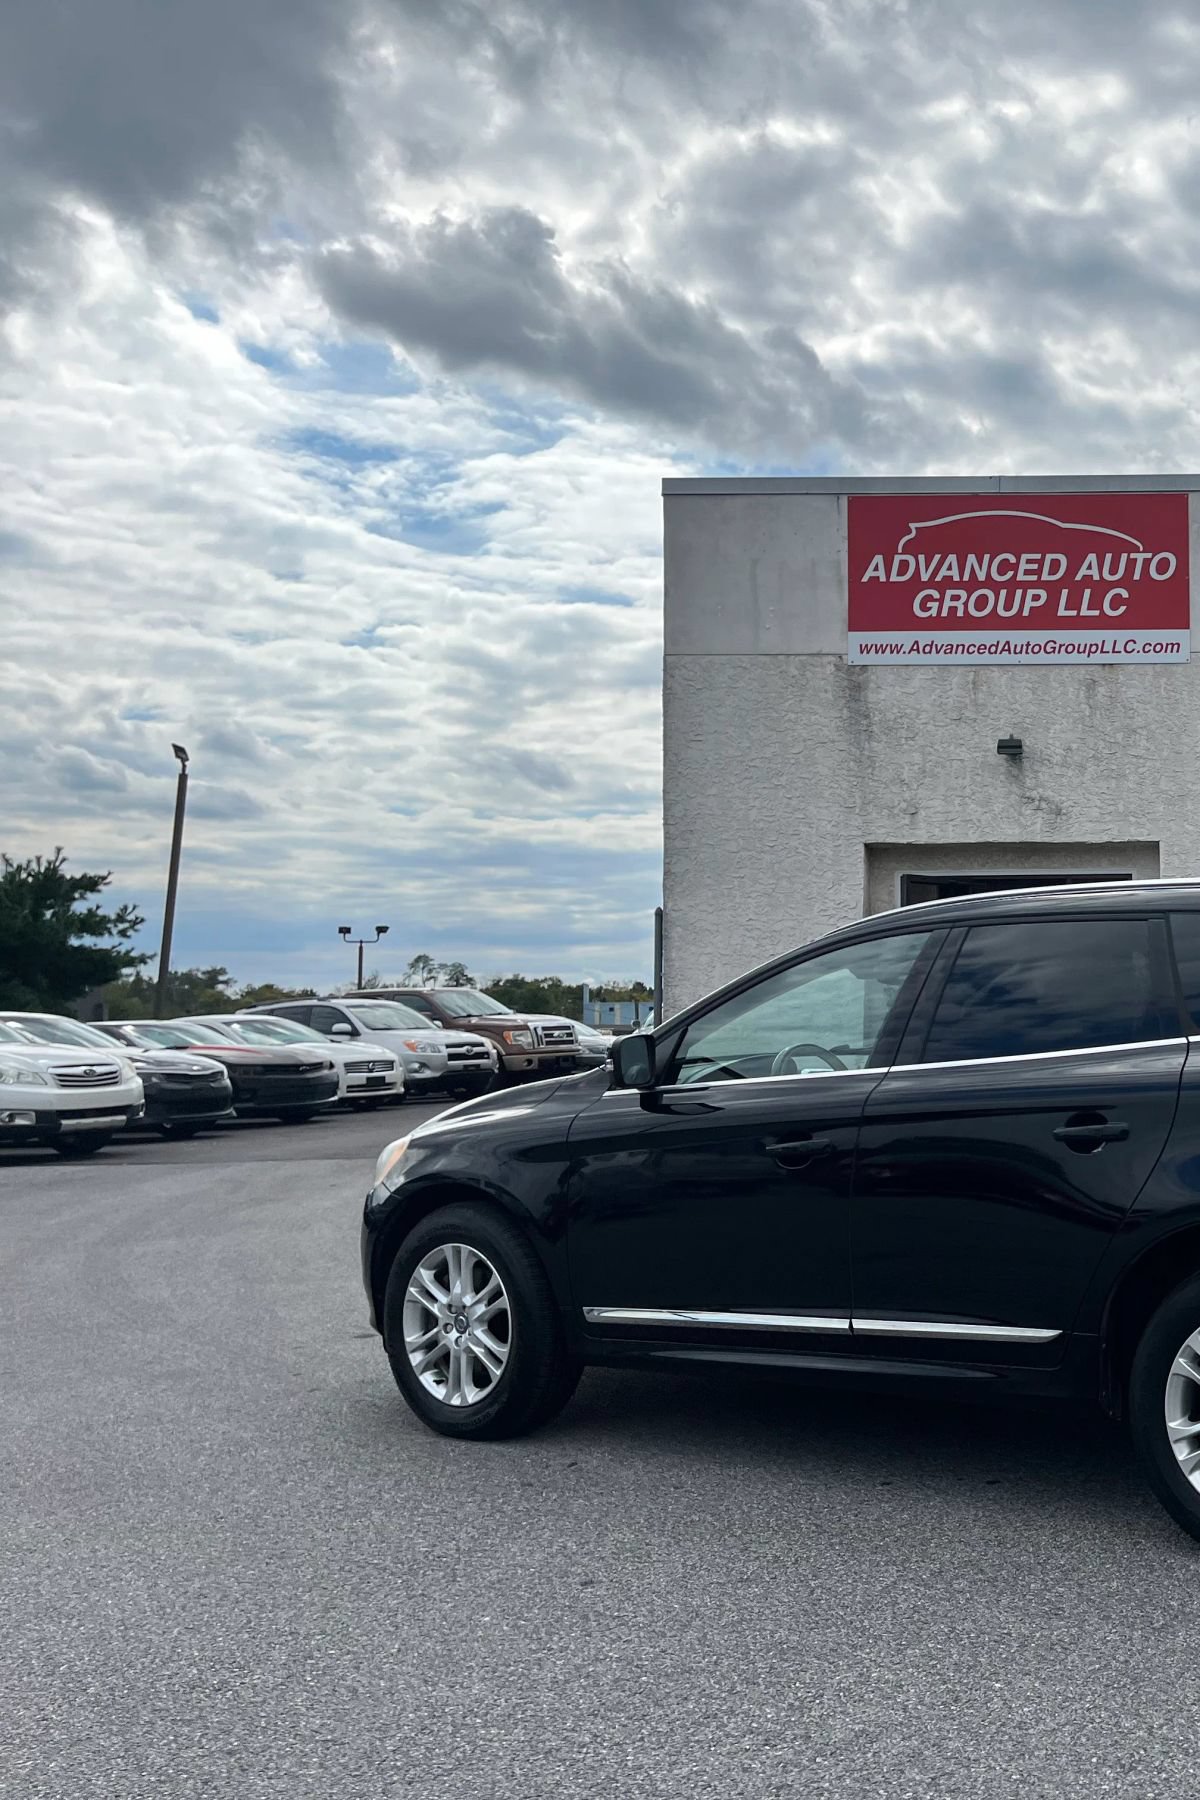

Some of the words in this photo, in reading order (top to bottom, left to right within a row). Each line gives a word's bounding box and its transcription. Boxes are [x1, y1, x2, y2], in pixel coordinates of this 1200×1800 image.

[861, 552, 1068, 583] ADVANCED
[1075, 551, 1177, 582] AUTO
[912, 588, 1048, 618] GROUP
[1056, 587, 1129, 617] LLC
[858, 639, 1181, 658] www.AdvancedAutoGroupLLC.com
